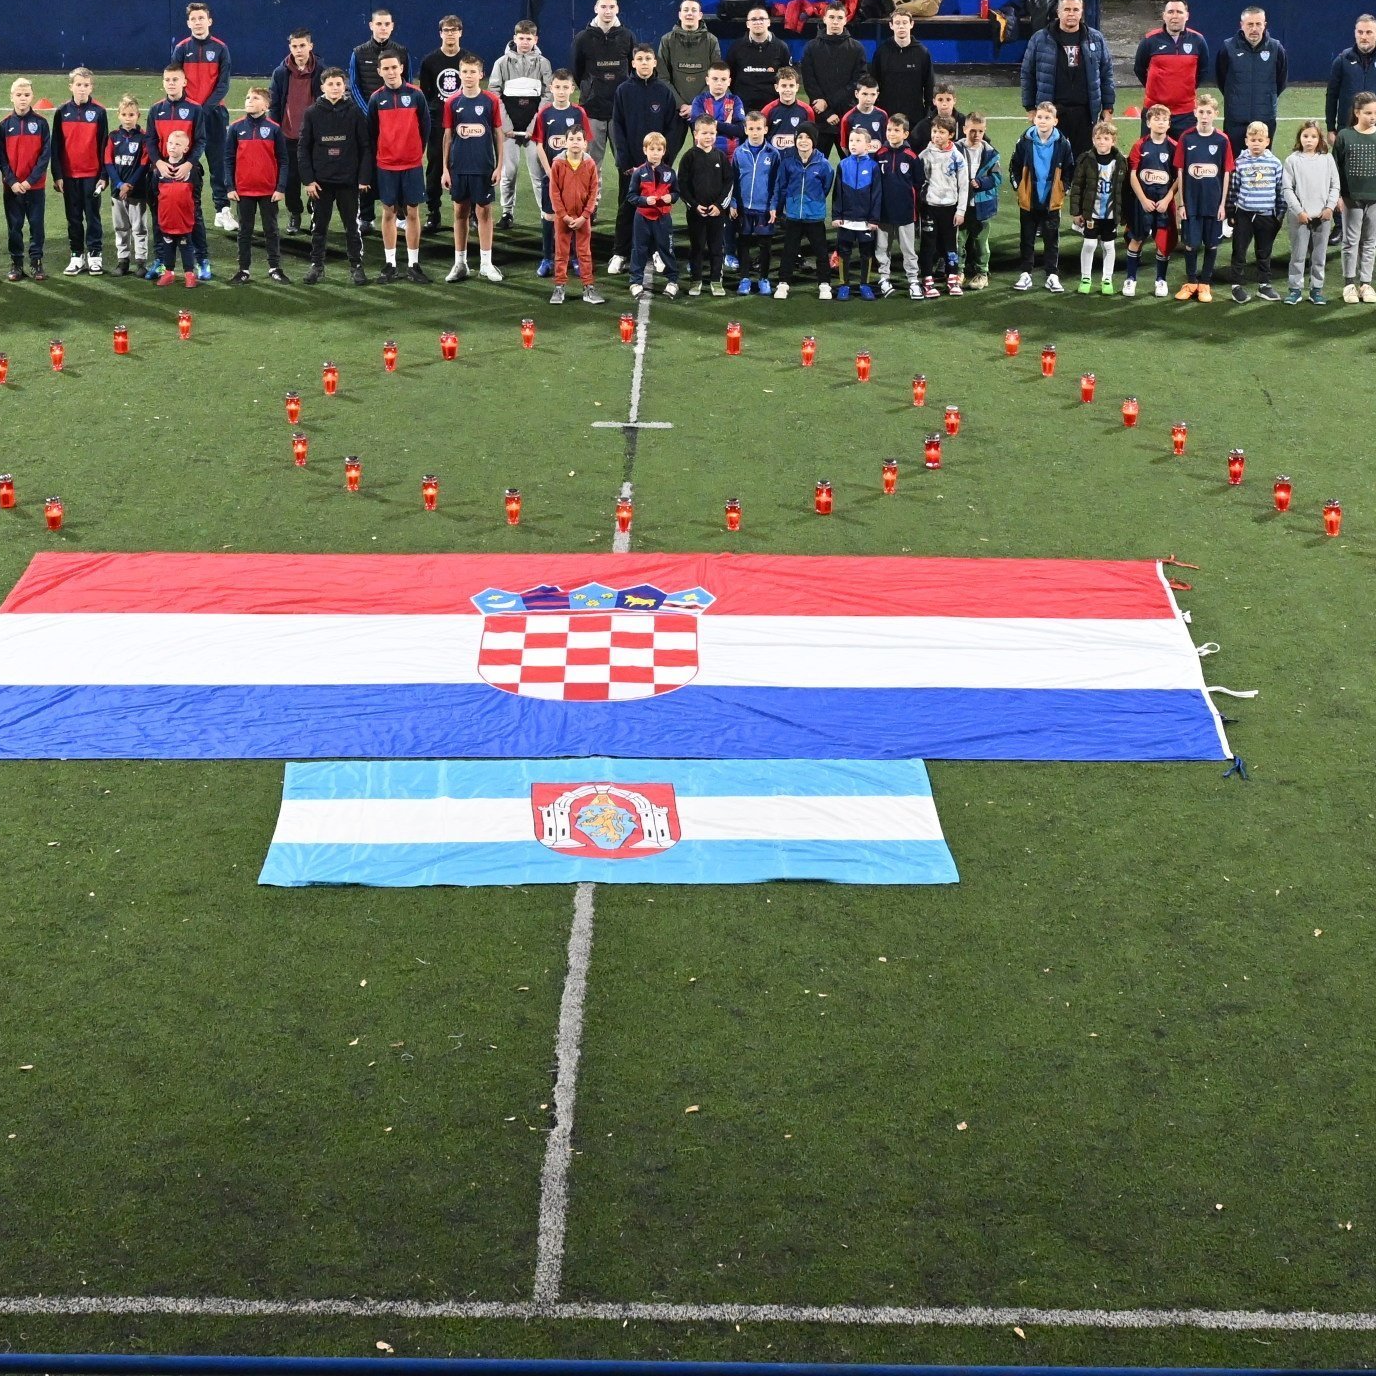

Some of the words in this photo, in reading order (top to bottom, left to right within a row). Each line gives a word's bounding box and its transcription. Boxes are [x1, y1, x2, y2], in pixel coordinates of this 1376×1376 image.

[460, 125, 482, 137] Tarsa
[1145, 171, 1167, 182] Tarsa
[1193, 165, 1216, 177] Tarsa
[1099, 181, 1111, 194] 10
